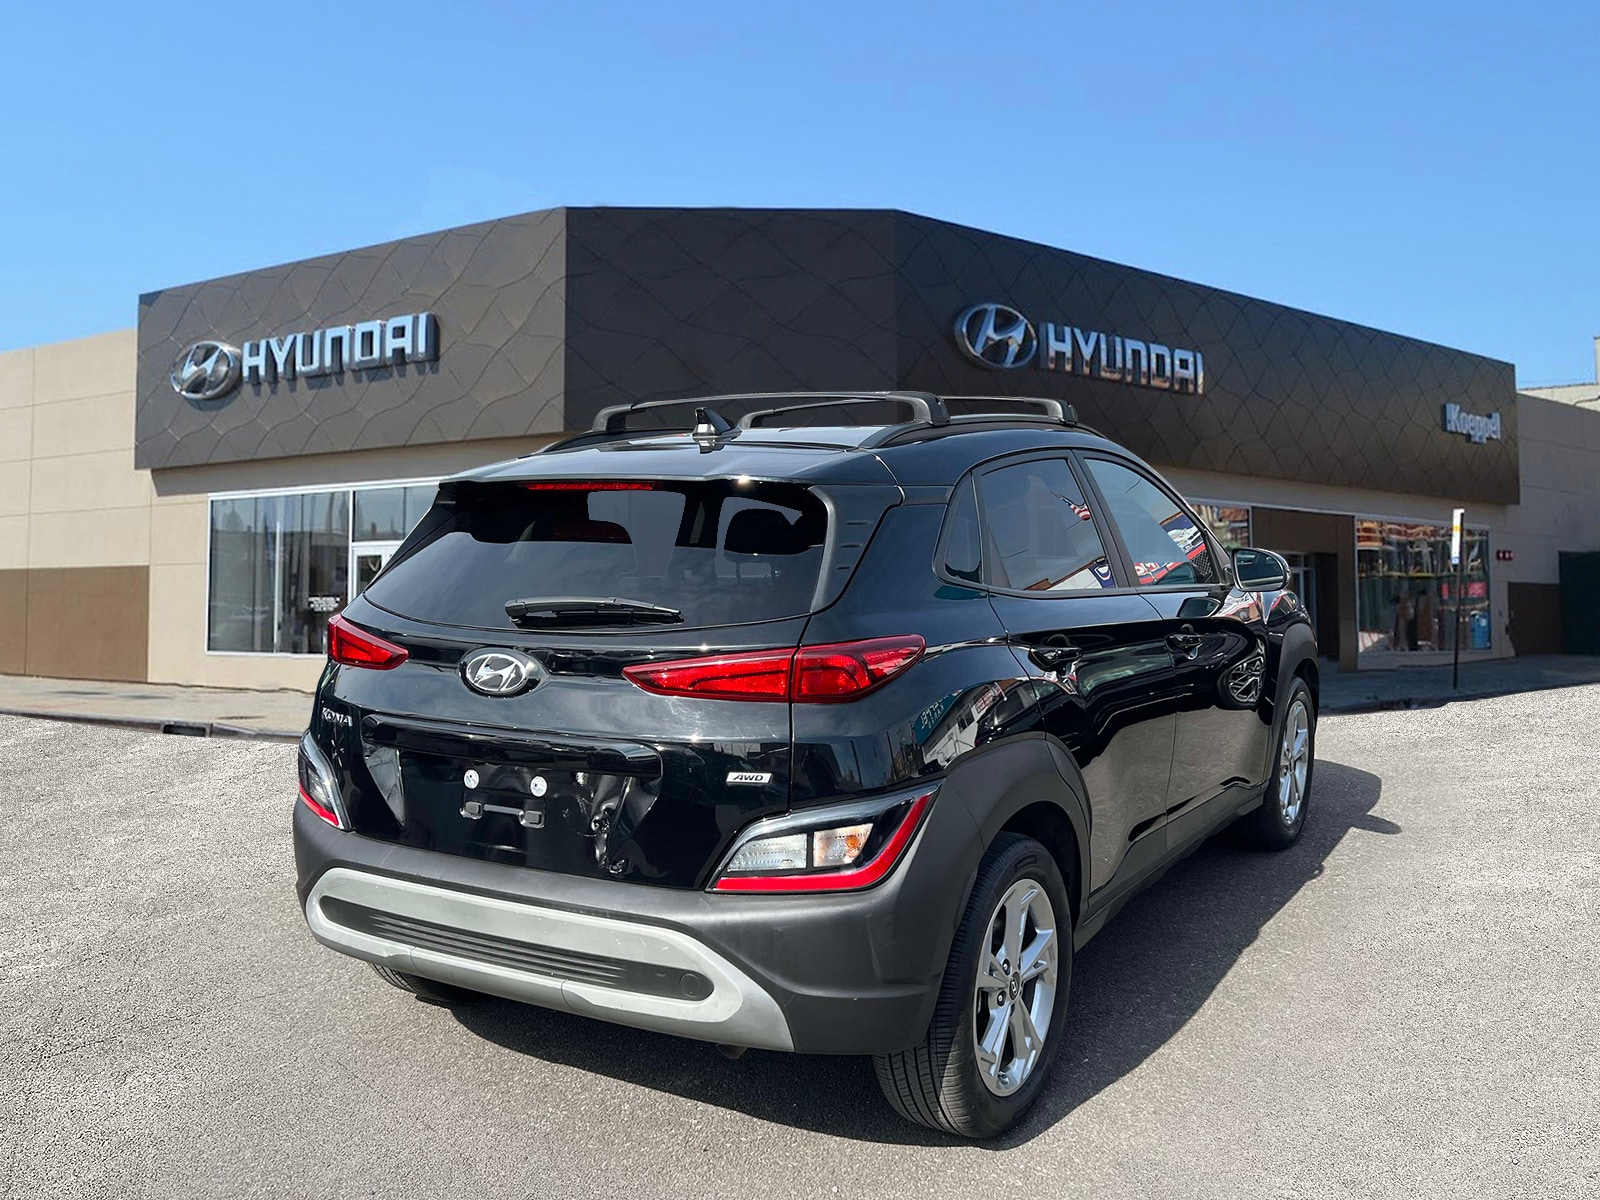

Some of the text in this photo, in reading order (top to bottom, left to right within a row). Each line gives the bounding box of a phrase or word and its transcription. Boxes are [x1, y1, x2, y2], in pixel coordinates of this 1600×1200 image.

[242, 312, 434, 382] HYUNDAI
[1045, 323, 1204, 394] HYUNDAI
[1445, 403, 1501, 443] Koeppel
